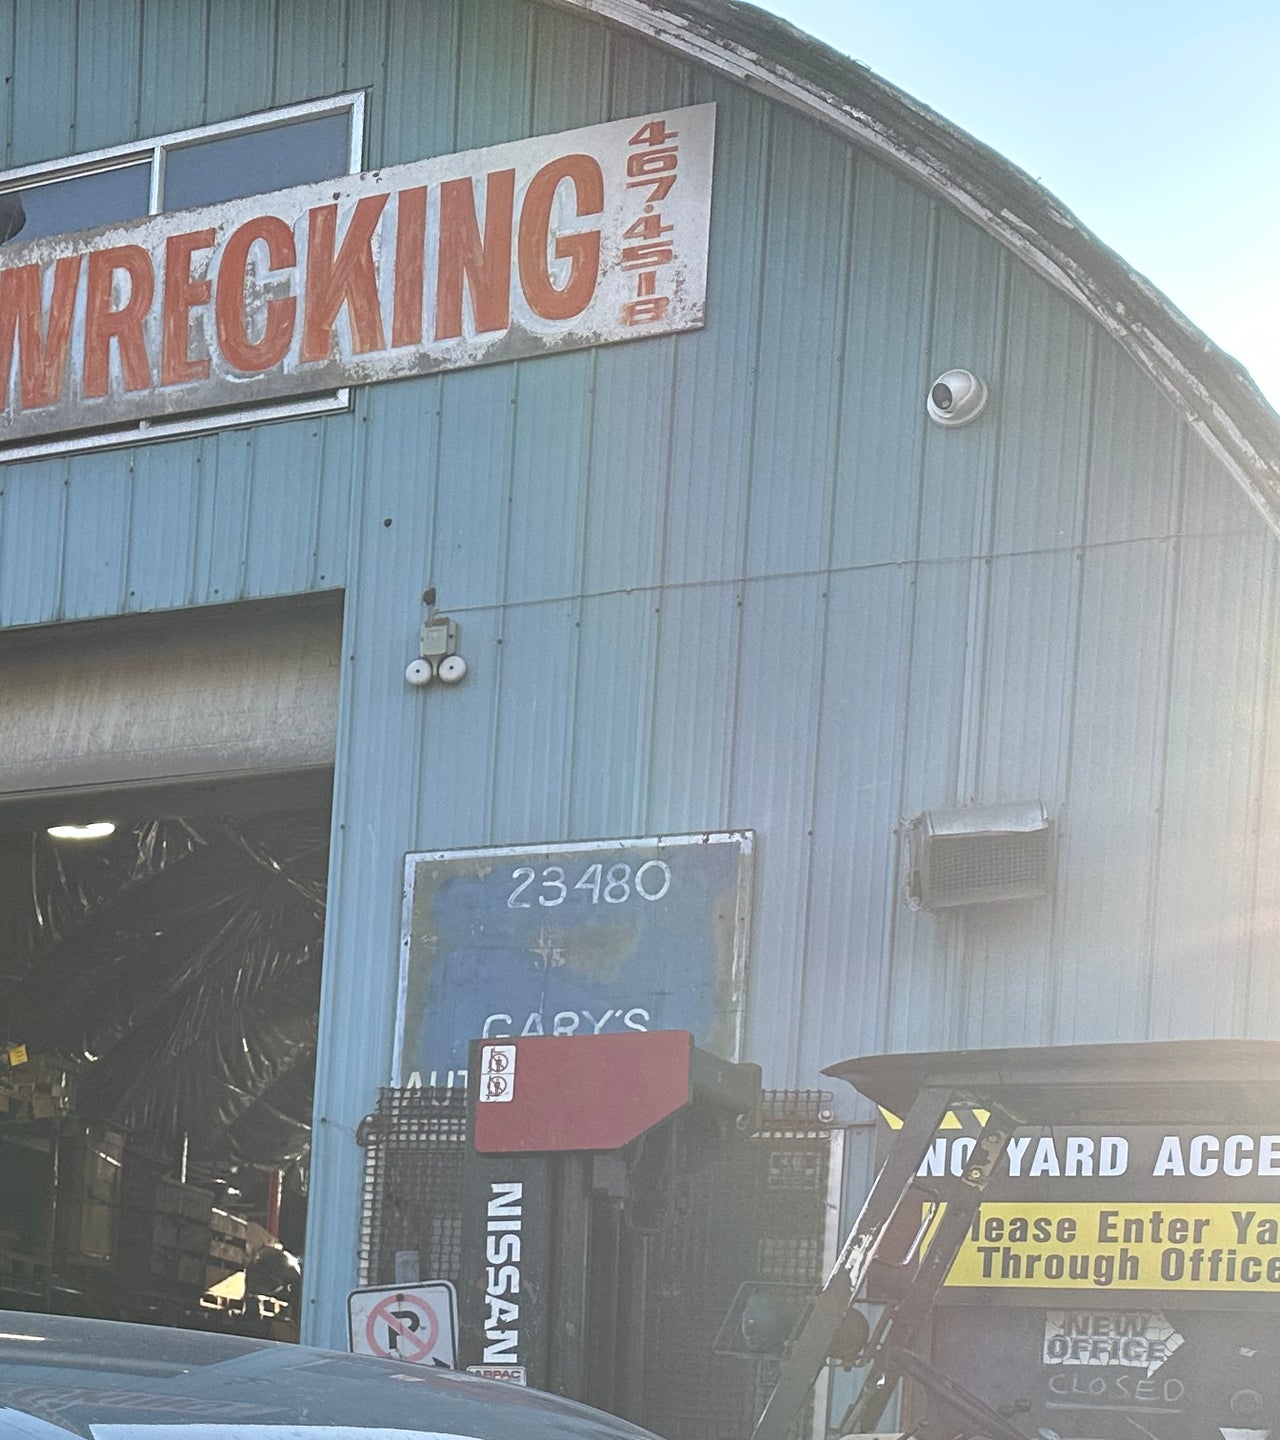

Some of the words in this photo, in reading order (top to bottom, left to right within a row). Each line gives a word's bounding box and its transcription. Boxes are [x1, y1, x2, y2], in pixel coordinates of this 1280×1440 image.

[506, 860, 672, 908] 23480
[1006, 1136, 1129, 1177] YARD
[971, 1209, 1077, 1244] lease
[1099, 1210, 1211, 1244] Enter
[483, 1182, 523, 1365] NISSAN
[977, 1246, 1139, 1286] Through
[1046, 1334, 1166, 1360] OFFICE
[1049, 1373, 1185, 1402] CLOSED
